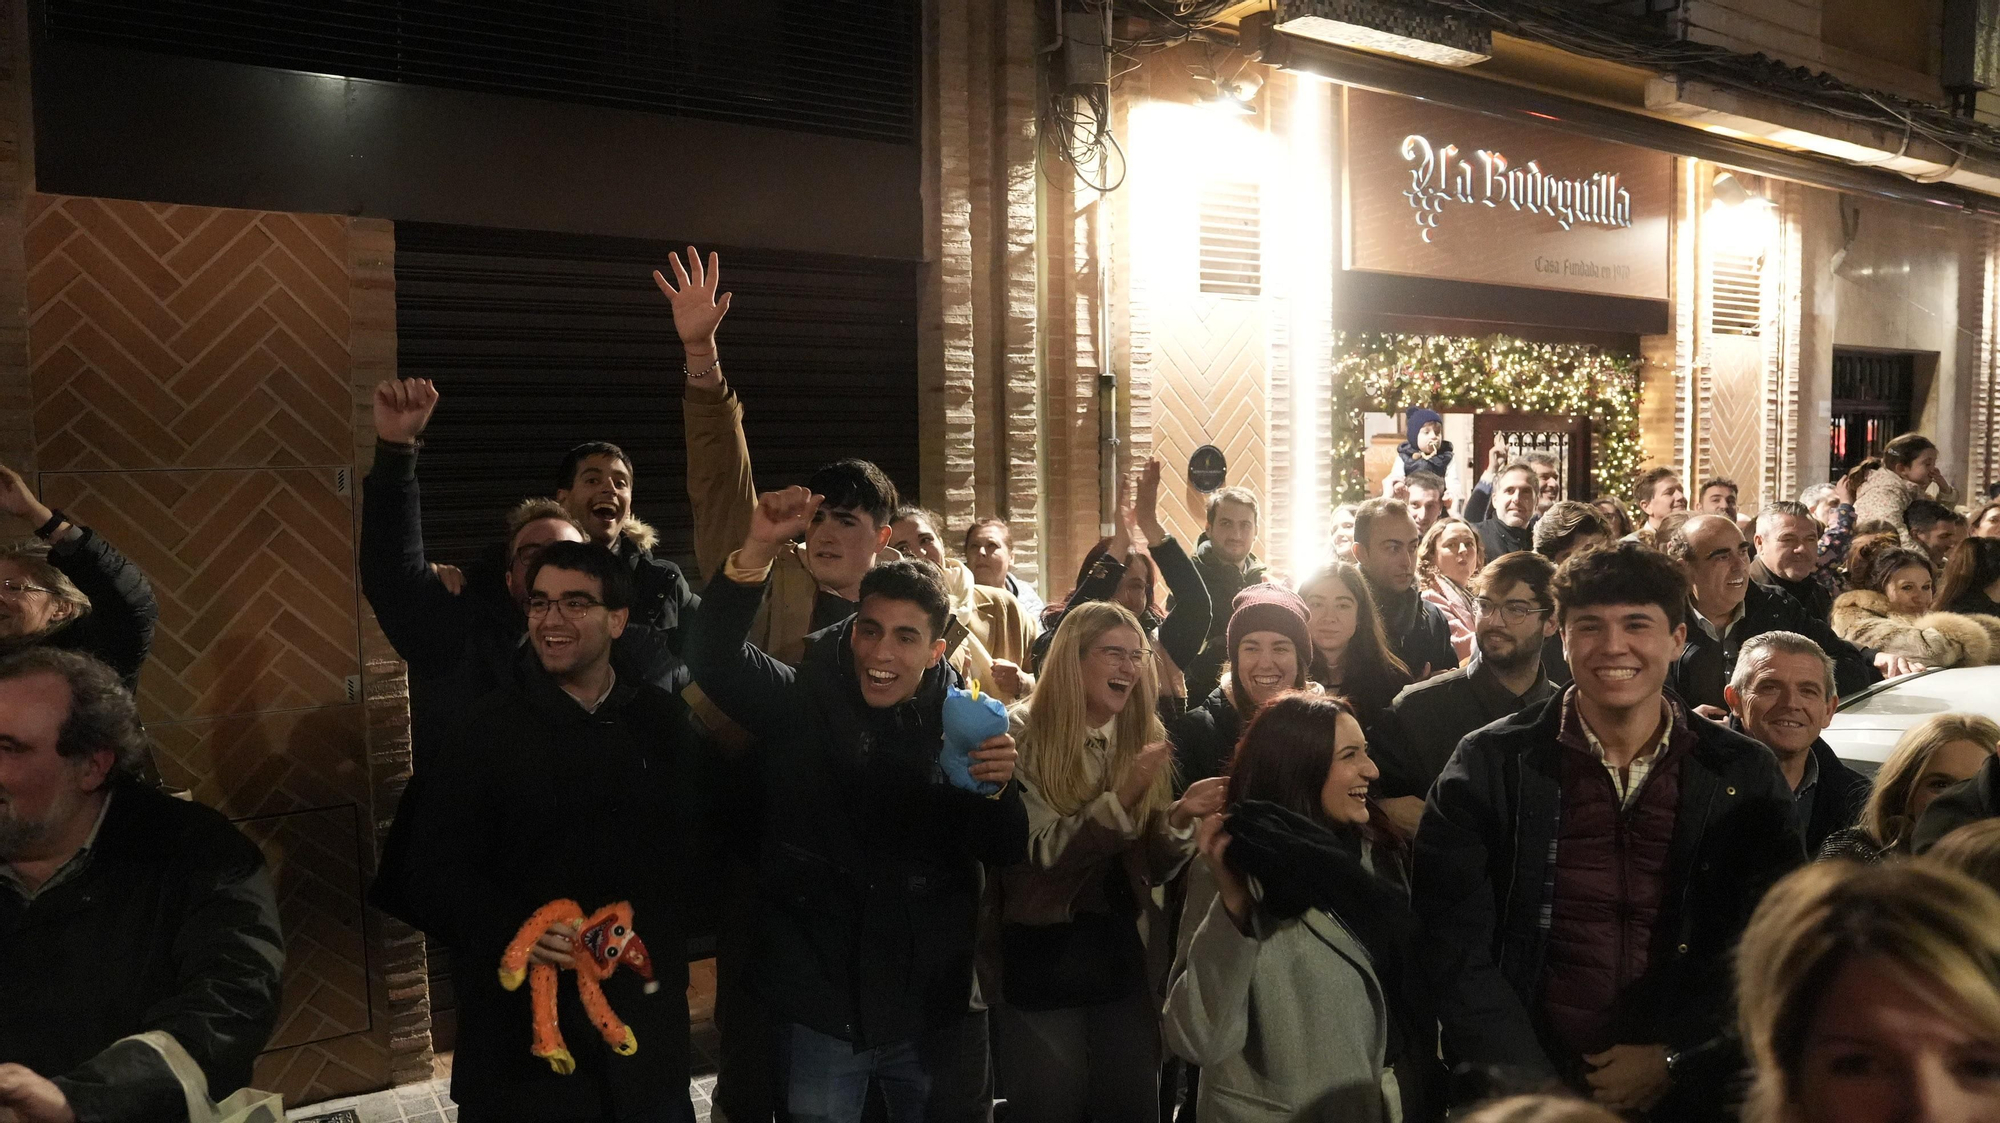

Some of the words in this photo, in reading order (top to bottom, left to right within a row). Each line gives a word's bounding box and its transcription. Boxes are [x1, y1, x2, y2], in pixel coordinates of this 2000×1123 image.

[1402, 134, 1474, 204] La
[1476, 149, 1632, 230] Bodeguilla
[1535, 255, 1559, 274] Casa
[1563, 259, 1599, 278] Fundada
[1601, 265, 1611, 279] en
